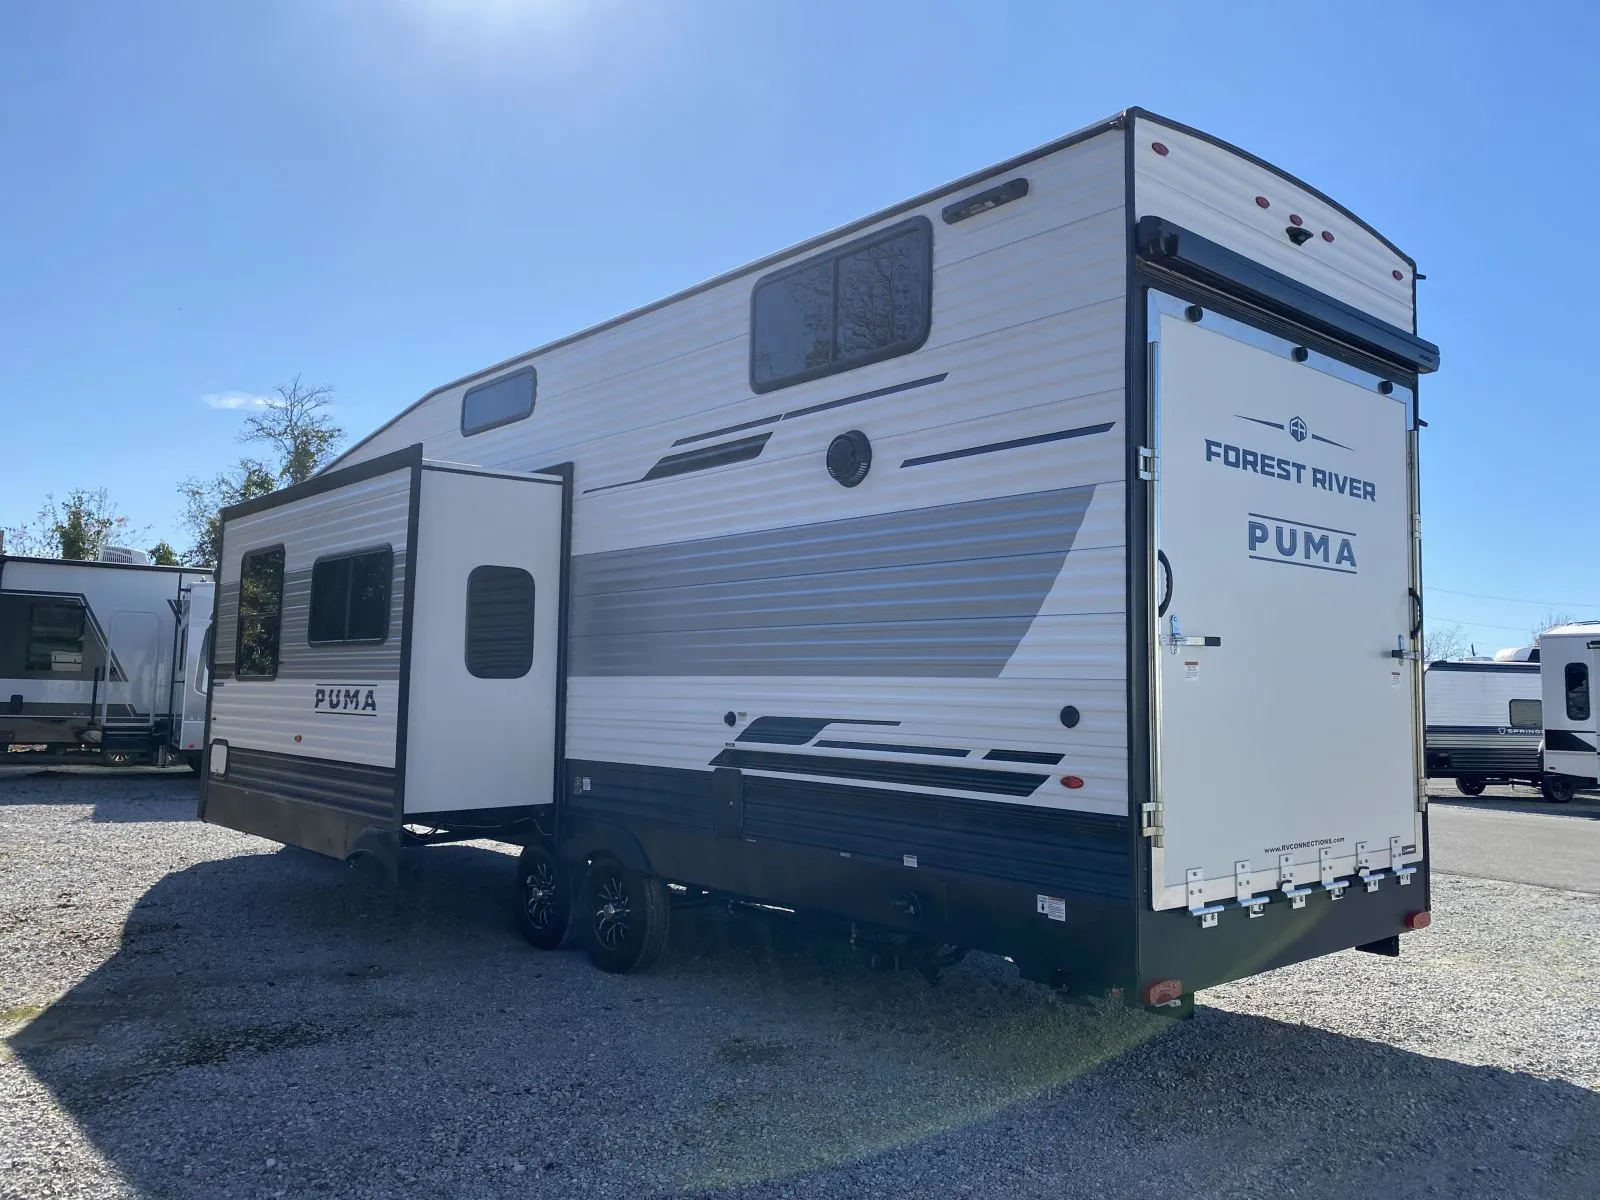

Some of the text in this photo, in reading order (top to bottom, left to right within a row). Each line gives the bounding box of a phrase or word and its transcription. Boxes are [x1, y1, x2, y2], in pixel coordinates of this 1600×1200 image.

[1205, 439, 1376, 502] FOREST RIVER
[1248, 520, 1357, 567] PUMA
[314, 689, 376, 711] PUMA
[1264, 837, 1345, 853] www.RVCONNECTIONS.com
